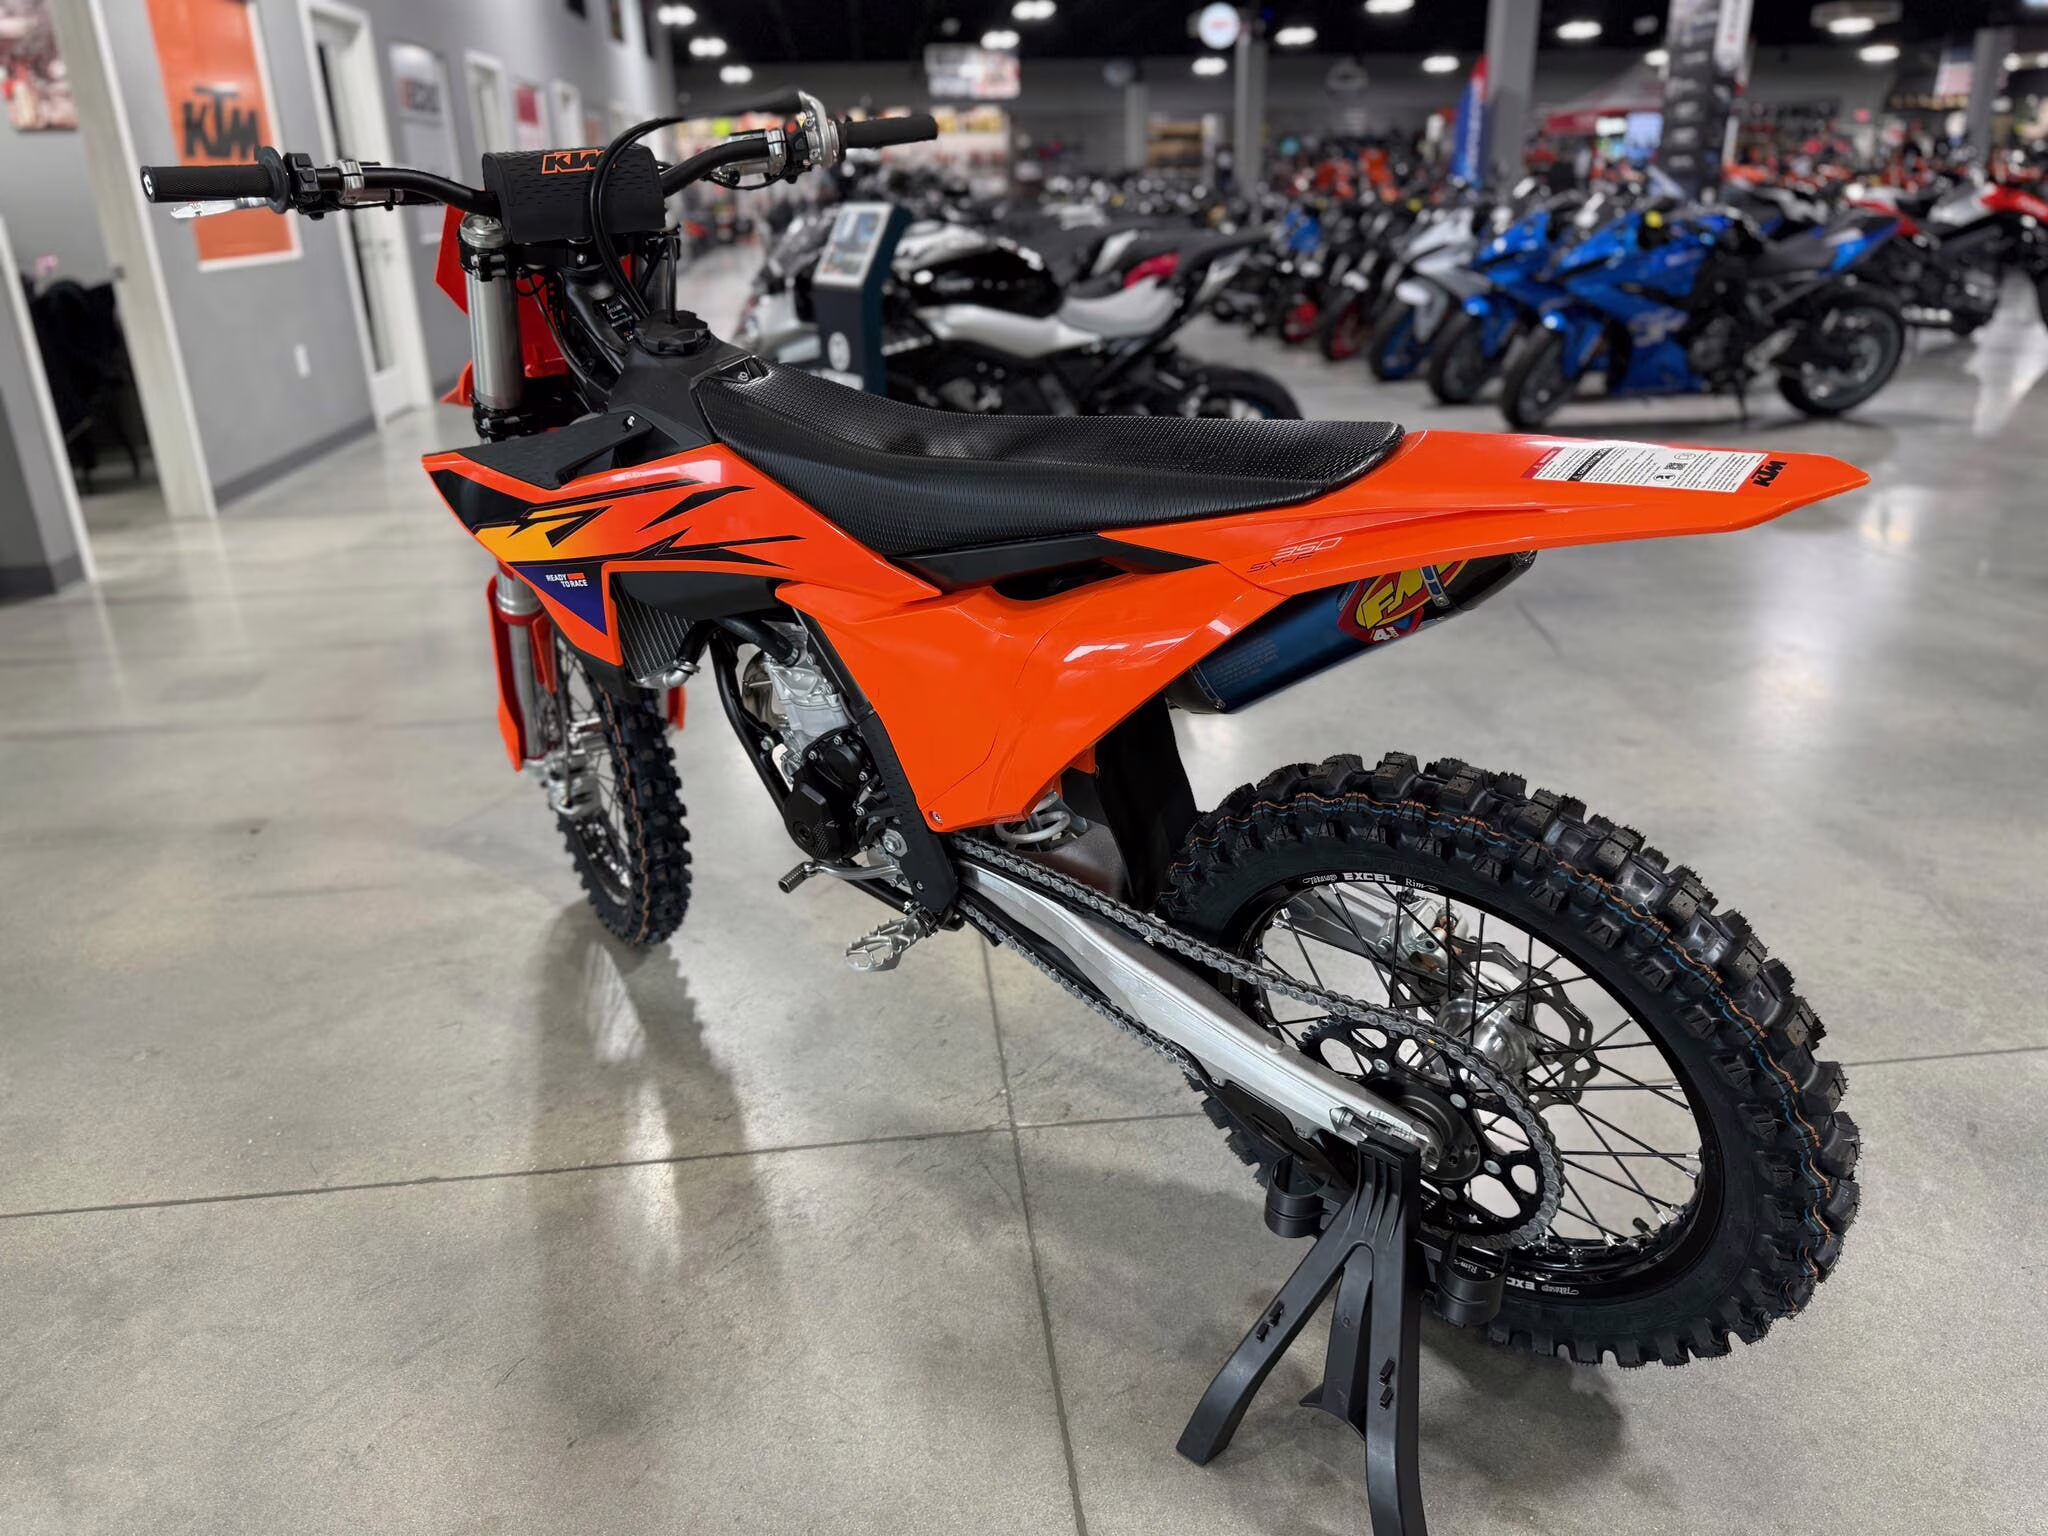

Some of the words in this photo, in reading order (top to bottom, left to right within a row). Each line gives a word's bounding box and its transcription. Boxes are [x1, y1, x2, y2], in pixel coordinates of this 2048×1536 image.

[183, 87, 258, 160] KTM
[1750, 460, 1788, 487] KTM
[1270, 536, 1343, 561] 350
[1247, 552, 1313, 574] SX-F
[545, 573, 567, 582] READY
[561, 580, 570, 588] TO
[569, 579, 588, 587] RACE
[1342, 872, 1397, 884] EXCEL
[1405, 878, 1432, 890] Rim
